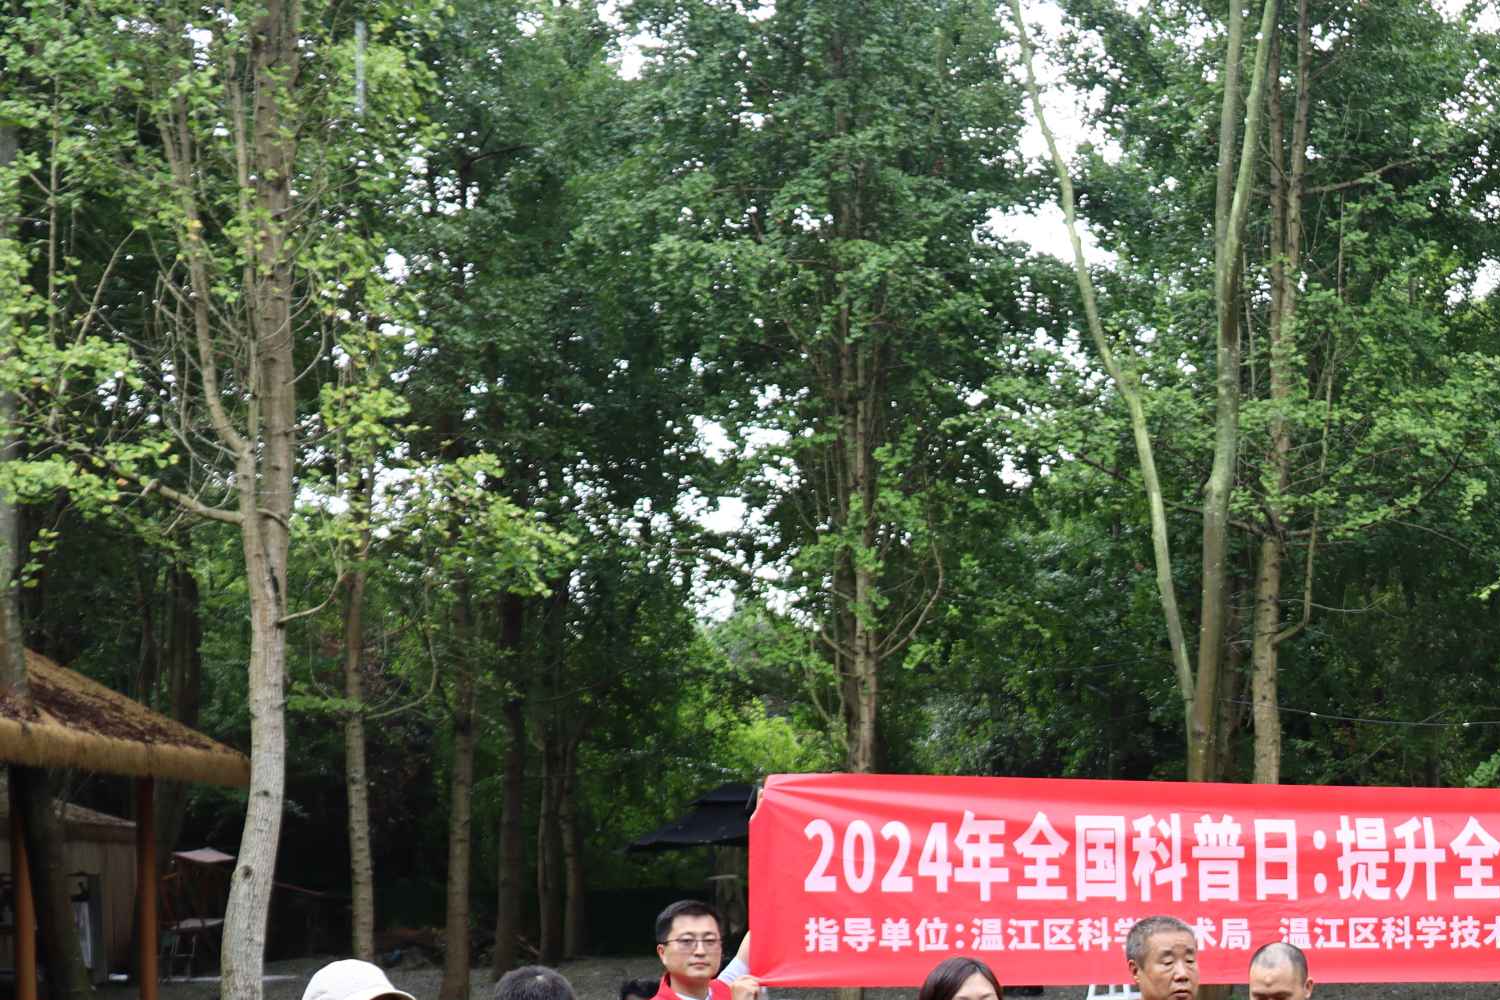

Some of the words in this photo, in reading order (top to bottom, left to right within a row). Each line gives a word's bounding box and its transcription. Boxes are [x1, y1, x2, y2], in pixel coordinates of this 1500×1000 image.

[804, 916, 1252, 952] 指导单位:温江区科术局
